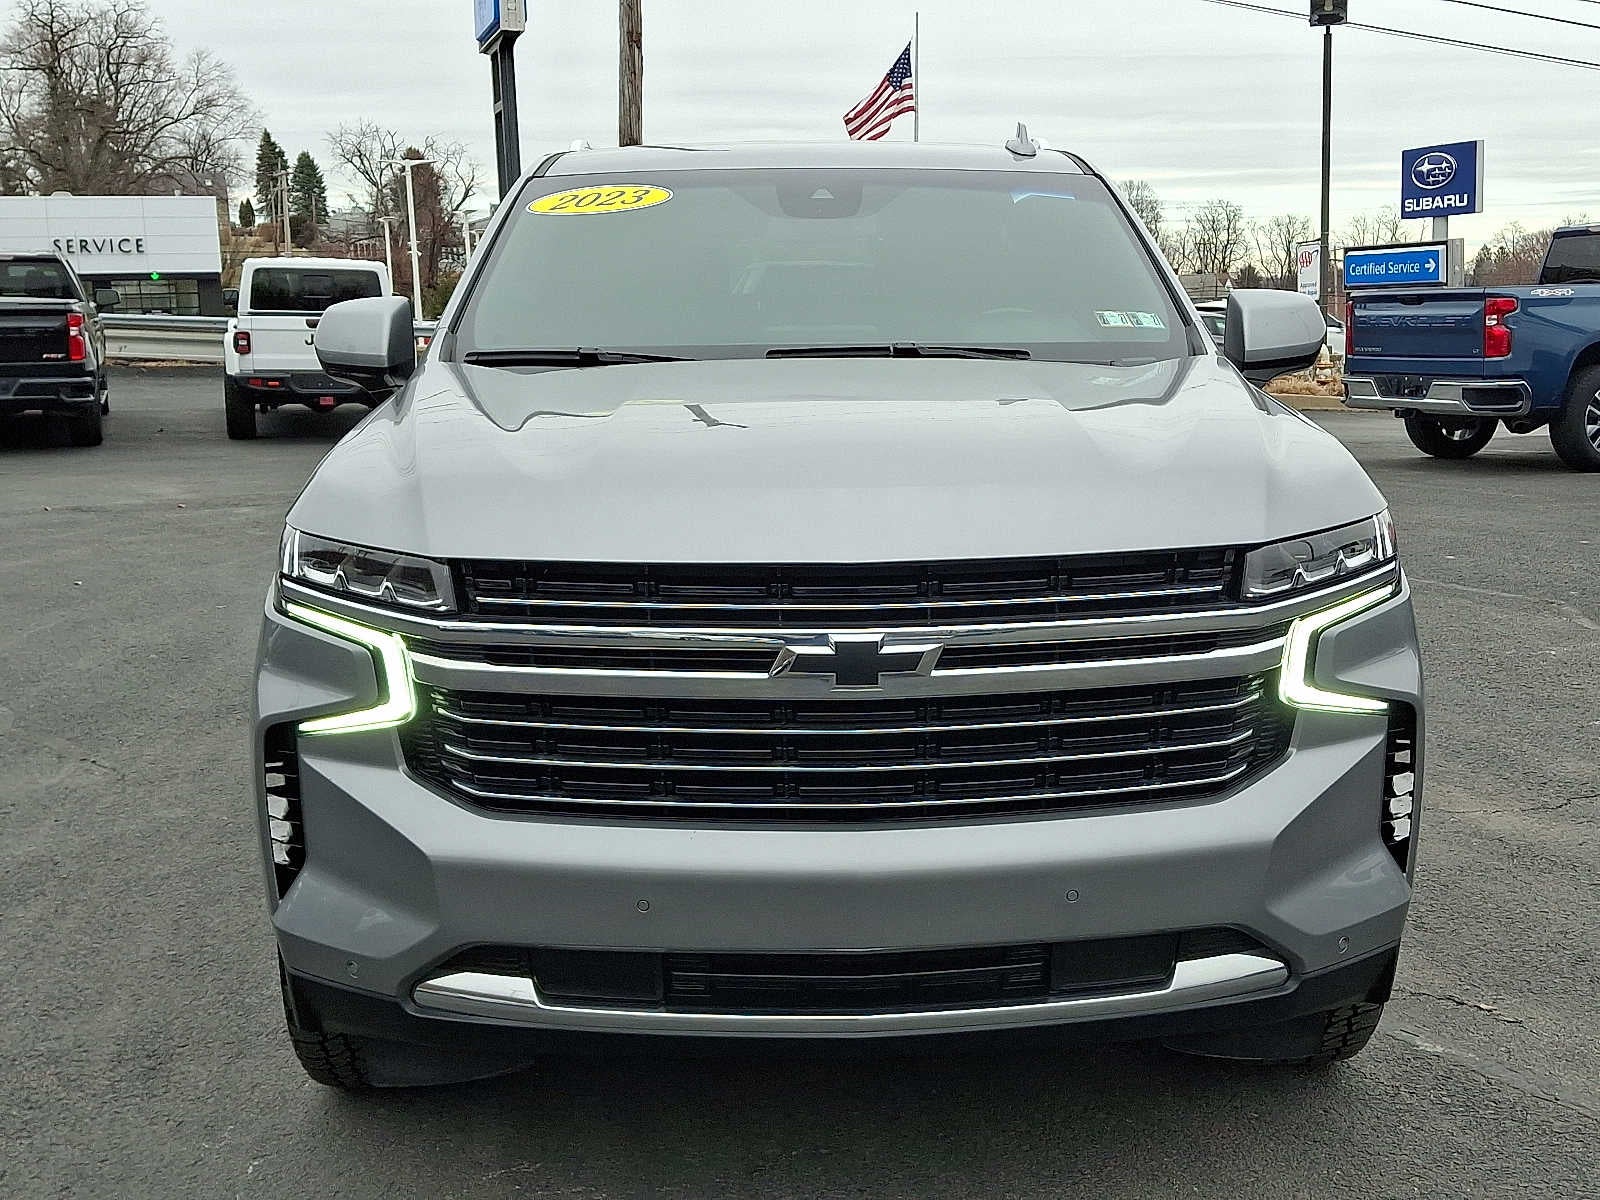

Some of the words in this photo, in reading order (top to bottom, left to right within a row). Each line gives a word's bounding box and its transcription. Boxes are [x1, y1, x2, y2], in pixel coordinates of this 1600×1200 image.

[548, 189, 651, 211] 2023
[1404, 193, 1468, 212] SUBARU
[53, 238, 145, 254] SERVICE
[1349, 261, 1386, 276] Certified
[1388, 260, 1420, 274] Service
